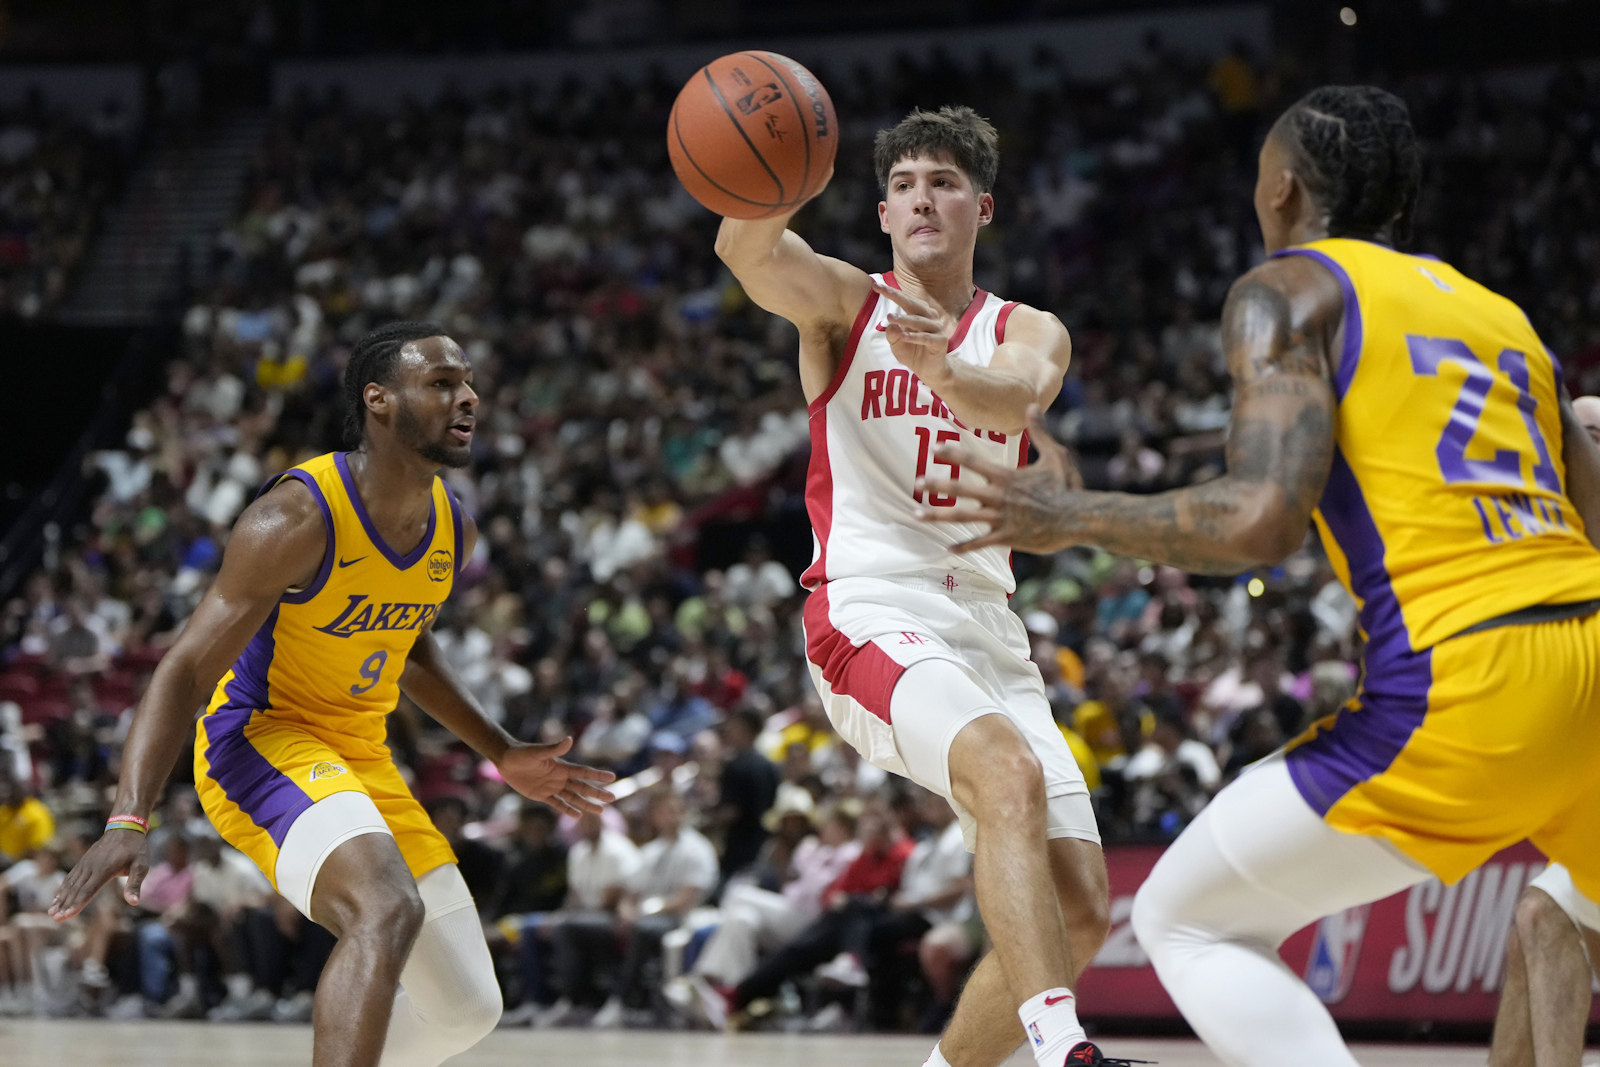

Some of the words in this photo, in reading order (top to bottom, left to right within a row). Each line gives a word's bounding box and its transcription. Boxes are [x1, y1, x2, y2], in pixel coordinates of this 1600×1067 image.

[861, 368, 1007, 445] ROCK
[1404, 333, 1563, 497] 21
[912, 426, 961, 508] 15
[430, 558, 452, 573] bibigo
[350, 650, 389, 696] 9
[1387, 862, 1549, 994] SUM
